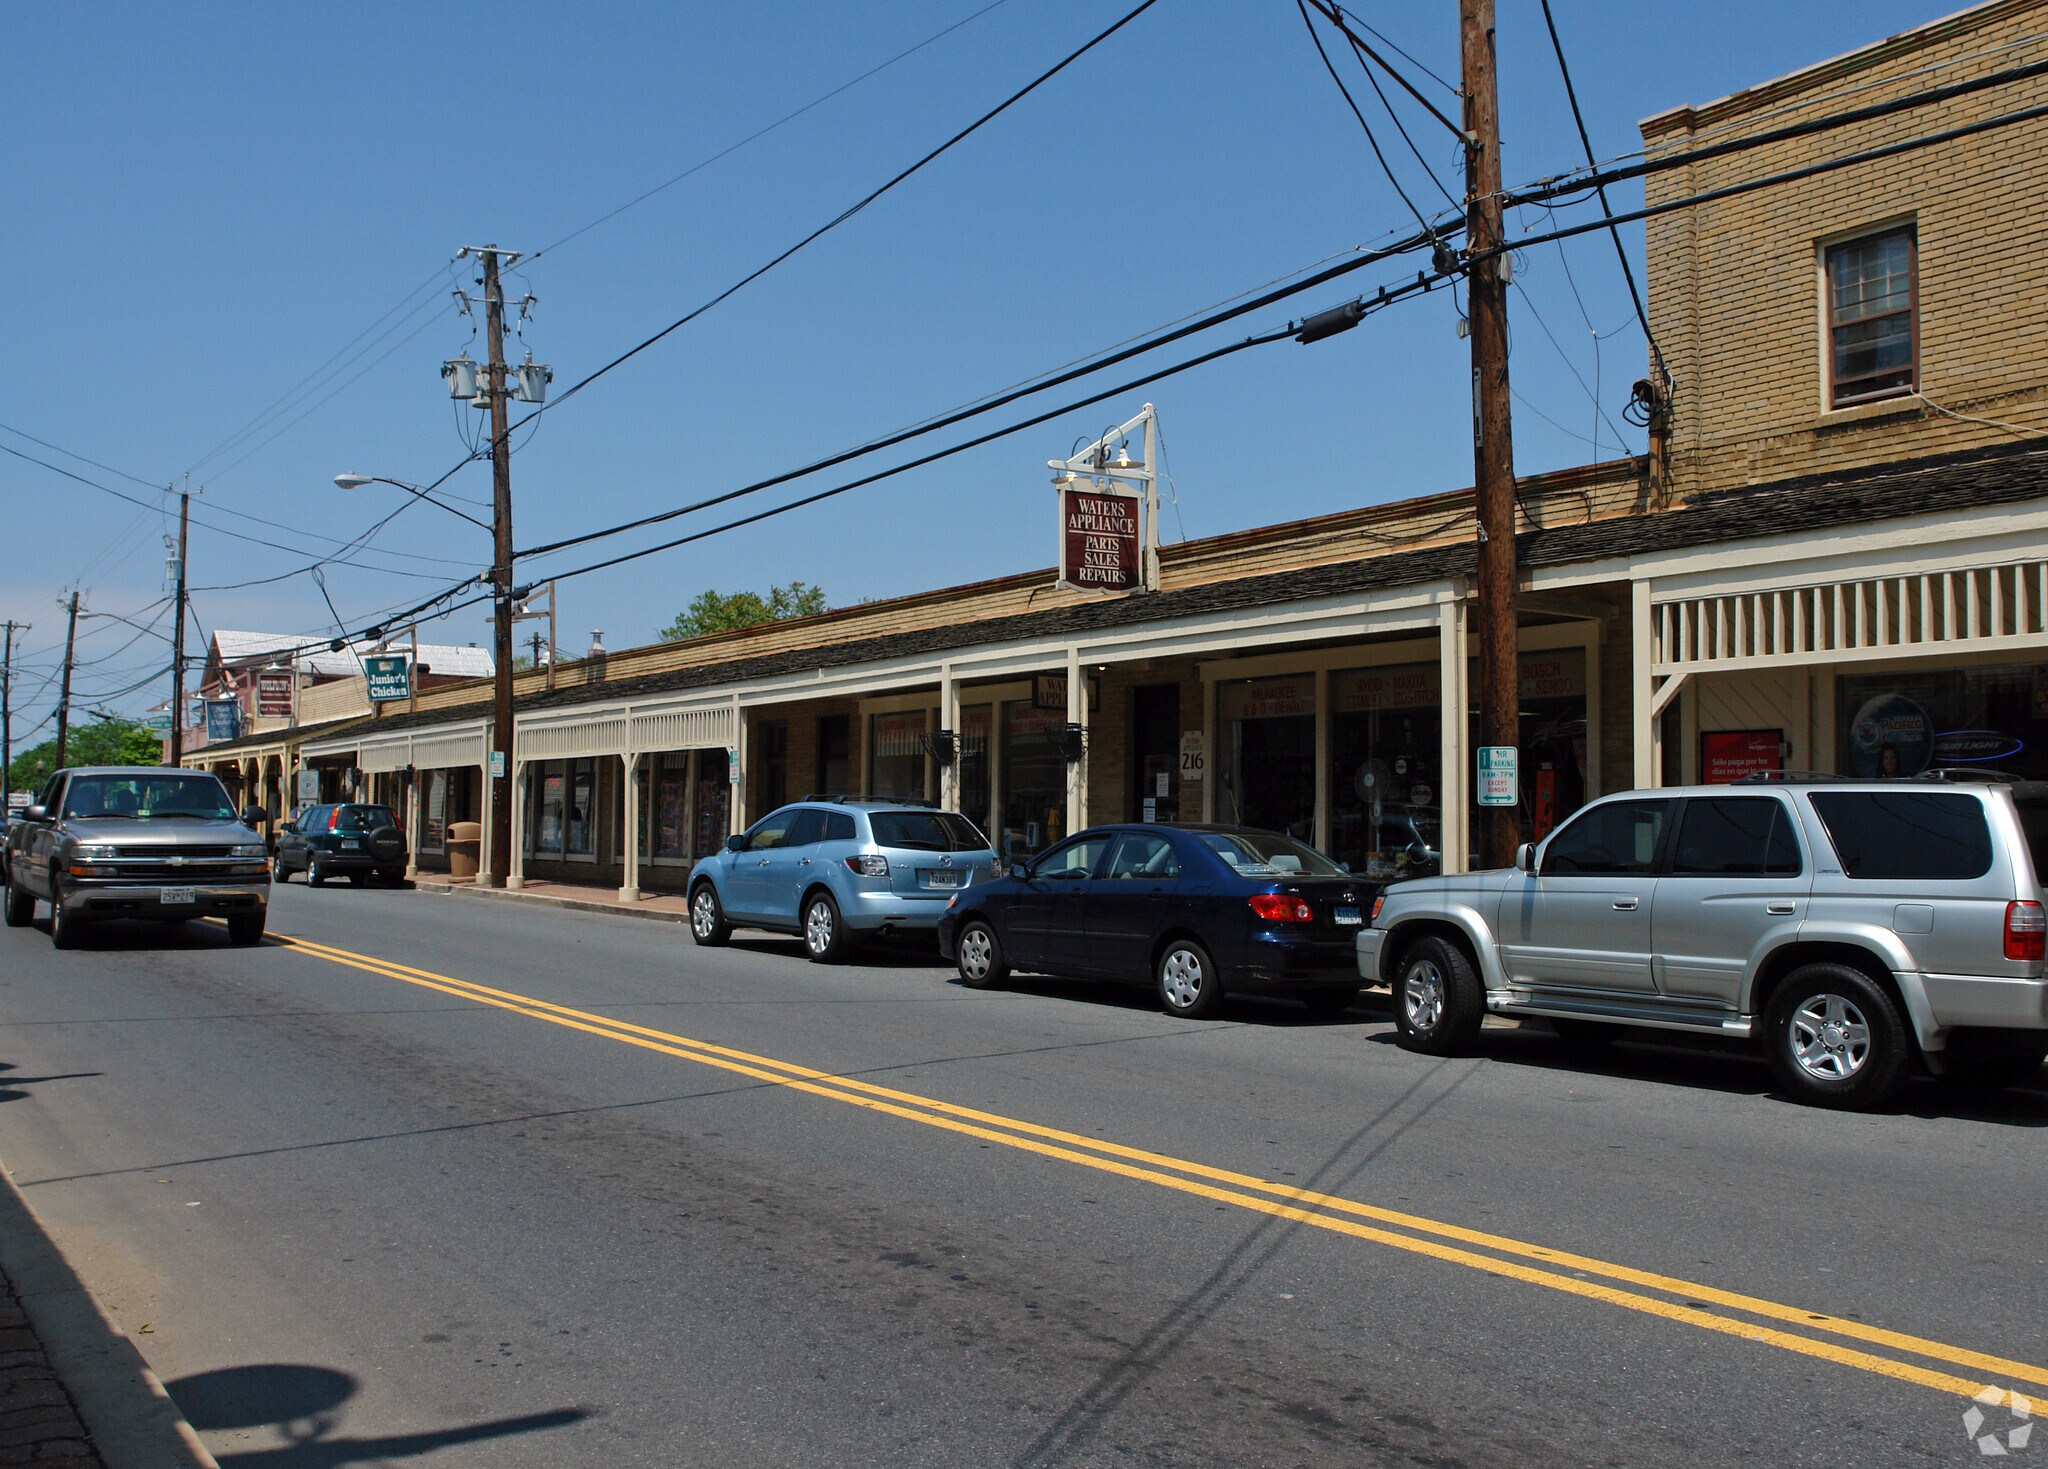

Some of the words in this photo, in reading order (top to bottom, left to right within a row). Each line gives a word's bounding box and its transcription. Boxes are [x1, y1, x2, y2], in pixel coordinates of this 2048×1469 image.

[1078, 498, 1125, 518] WATERS
[1069, 513, 1135, 533] APPLIANCE
[1086, 536, 1119, 551] PARTS
[1085, 552, 1119, 566] SALES
[1079, 568, 1126, 584] REPAIRS
[1523, 662, 1561, 679] BOSCH
[370, 673, 406, 685] Junior's
[1393, 673, 1425, 690] MAKITA
[371, 687, 407, 697] Chicken
[1535, 677, 1574, 695] SENCO
[1880, 718, 1923, 731] PACIFICO
[1963, 741, 2002, 750] LIGHT
[960, 748, 977, 761] yson
[1497, 750, 1508, 758] HR
[1182, 752, 1204, 770] 216
[1490, 760, 1515, 768] PARKING
[1712, 757, 1727, 766] Sólo
[1728, 759, 1745, 767] paga
[1746, 758, 1757, 766] por
[1758, 757, 1768, 765] los
[1737, 767, 1749, 776] que
